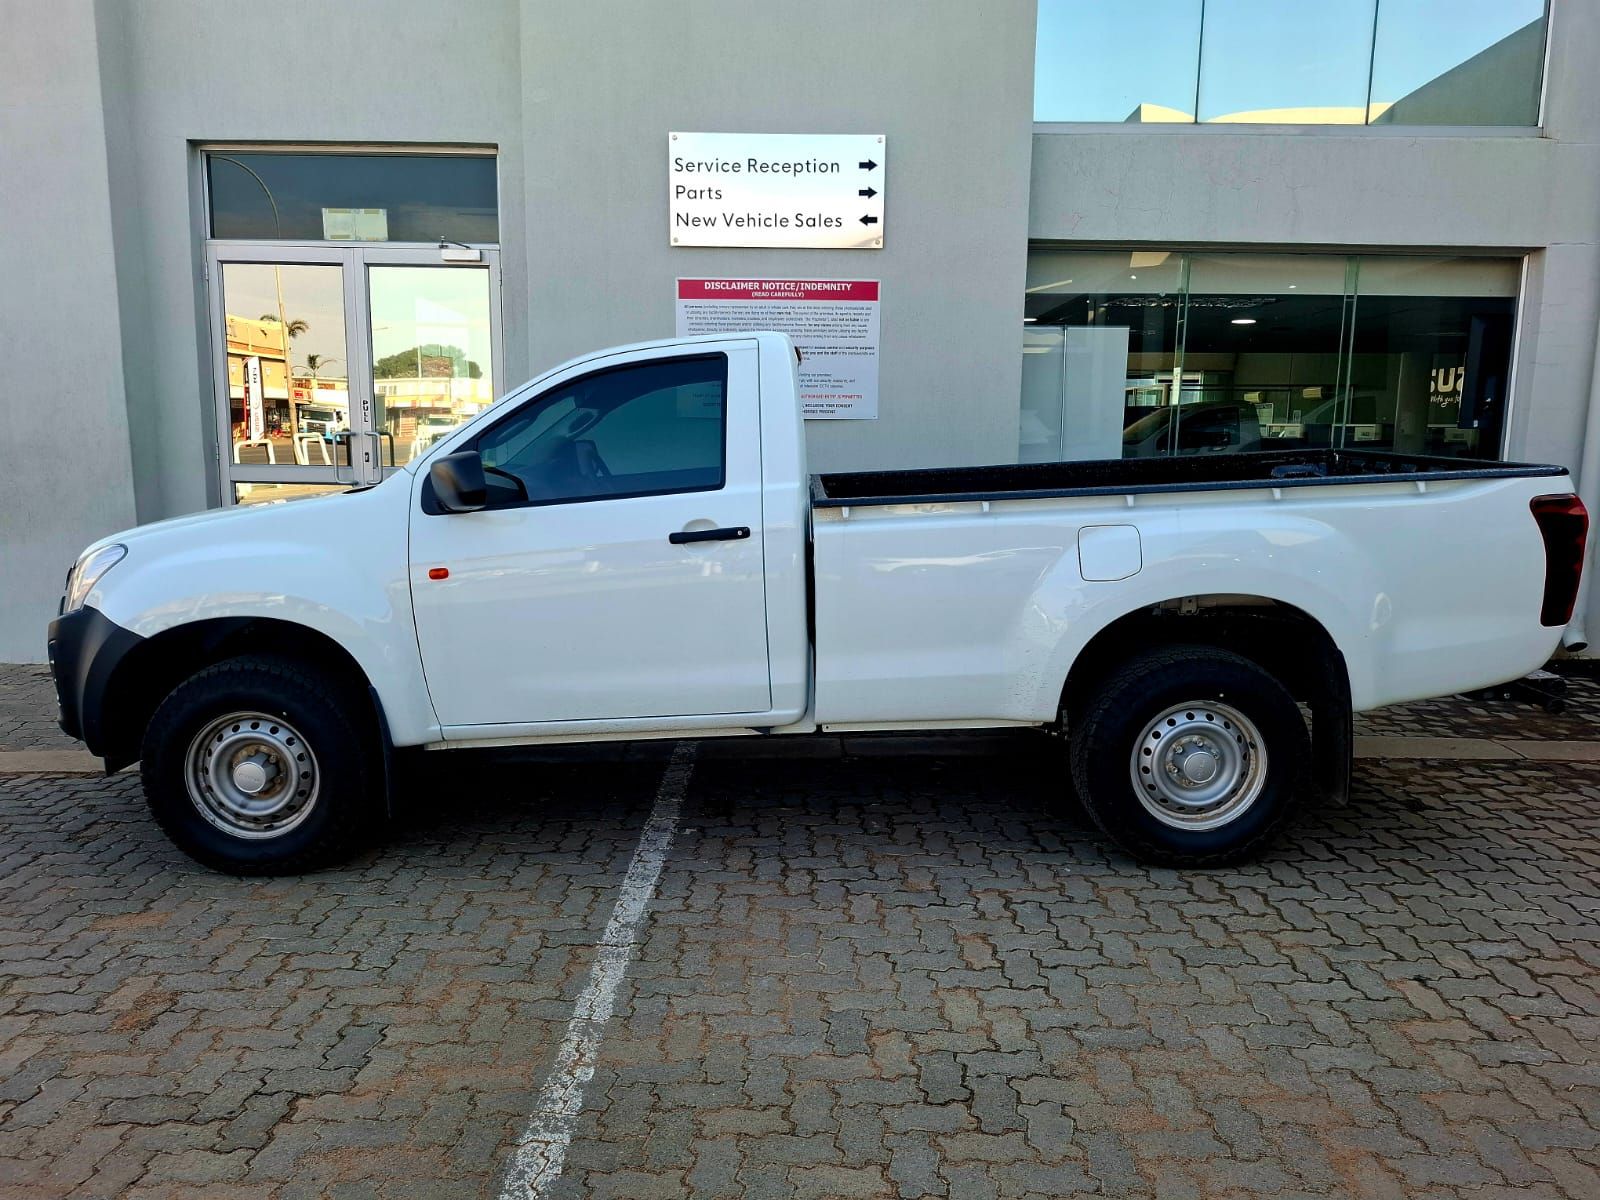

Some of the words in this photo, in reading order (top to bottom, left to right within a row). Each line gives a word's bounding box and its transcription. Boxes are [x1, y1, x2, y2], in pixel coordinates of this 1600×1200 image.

[674, 157, 742, 173] Service
[747, 158, 840, 177] Reception
[675, 184, 722, 200] Parts
[676, 212, 717, 227] New
[722, 212, 789, 228] Vehicle
[795, 213, 843, 228] Sales
[704, 281, 760, 291] DISCLAIMER
[762, 281, 852, 292] NOTICE/INDEMNITY
